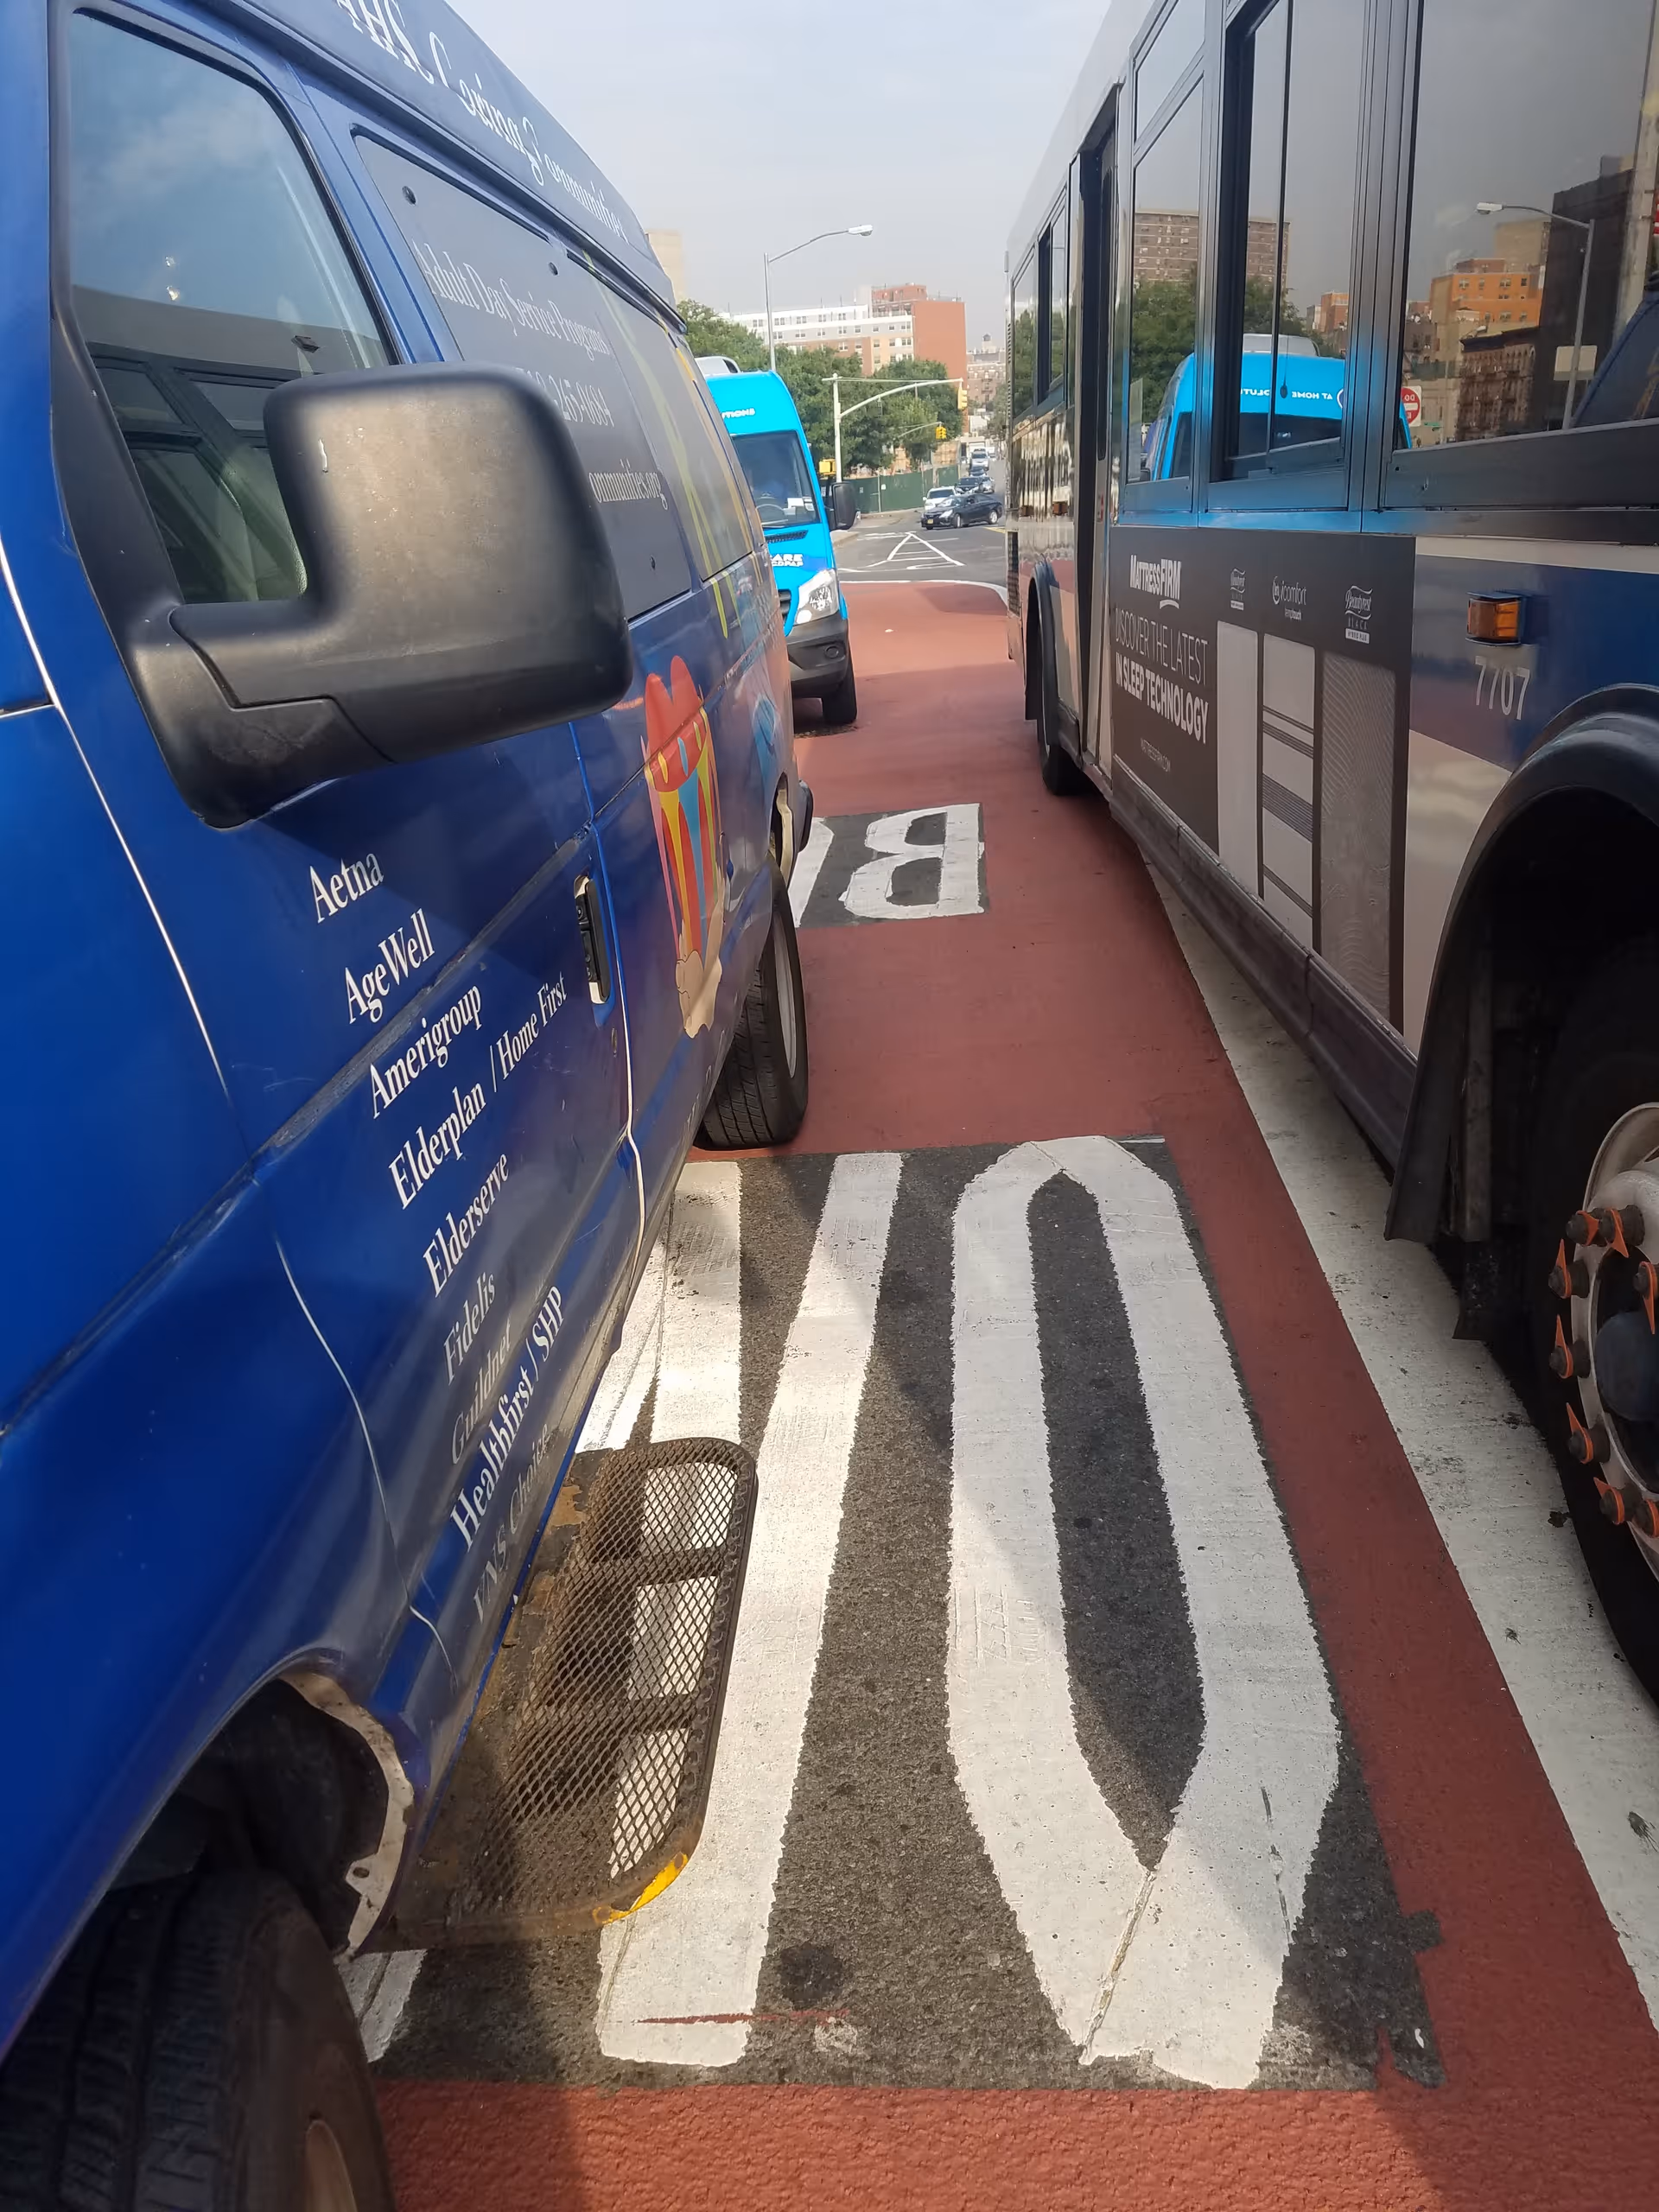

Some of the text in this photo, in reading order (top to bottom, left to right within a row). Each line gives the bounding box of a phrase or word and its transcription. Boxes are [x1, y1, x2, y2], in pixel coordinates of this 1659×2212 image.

[522, 117, 630, 245] Communities
[411, 238, 474, 308] Adult
[463, 262, 518, 337] Day
[499, 277, 556, 337] Service
[515, 366, 614, 427] -265-0684
[588, 457, 668, 511] ommunities.org
[1115, 607, 1209, 686] DISCOVER THE LATEST
[1116, 652, 1209, 744] IN SLEEP TECHNOLOGY
[1474, 655, 1530, 721] 7707
[309, 852, 385, 924] Aetna
[345, 908, 435, 1025] AgeWell
[370, 985, 482, 1120] Amerigroup
[389, 1083, 486, 1210] Elderplan
[496, 1012, 539, 1080] Home
[537, 971, 568, 1027] First
[423, 1154, 509, 1298] Elderserve
[443, 1272, 496, 1386] Fidelis
[450, 1365, 534, 1553] Healthfirst
[532, 1286, 564, 1363] SHP
[451, 1313, 512, 1465] Guildnet
[474, 1423, 551, 1624] VNS Choice
